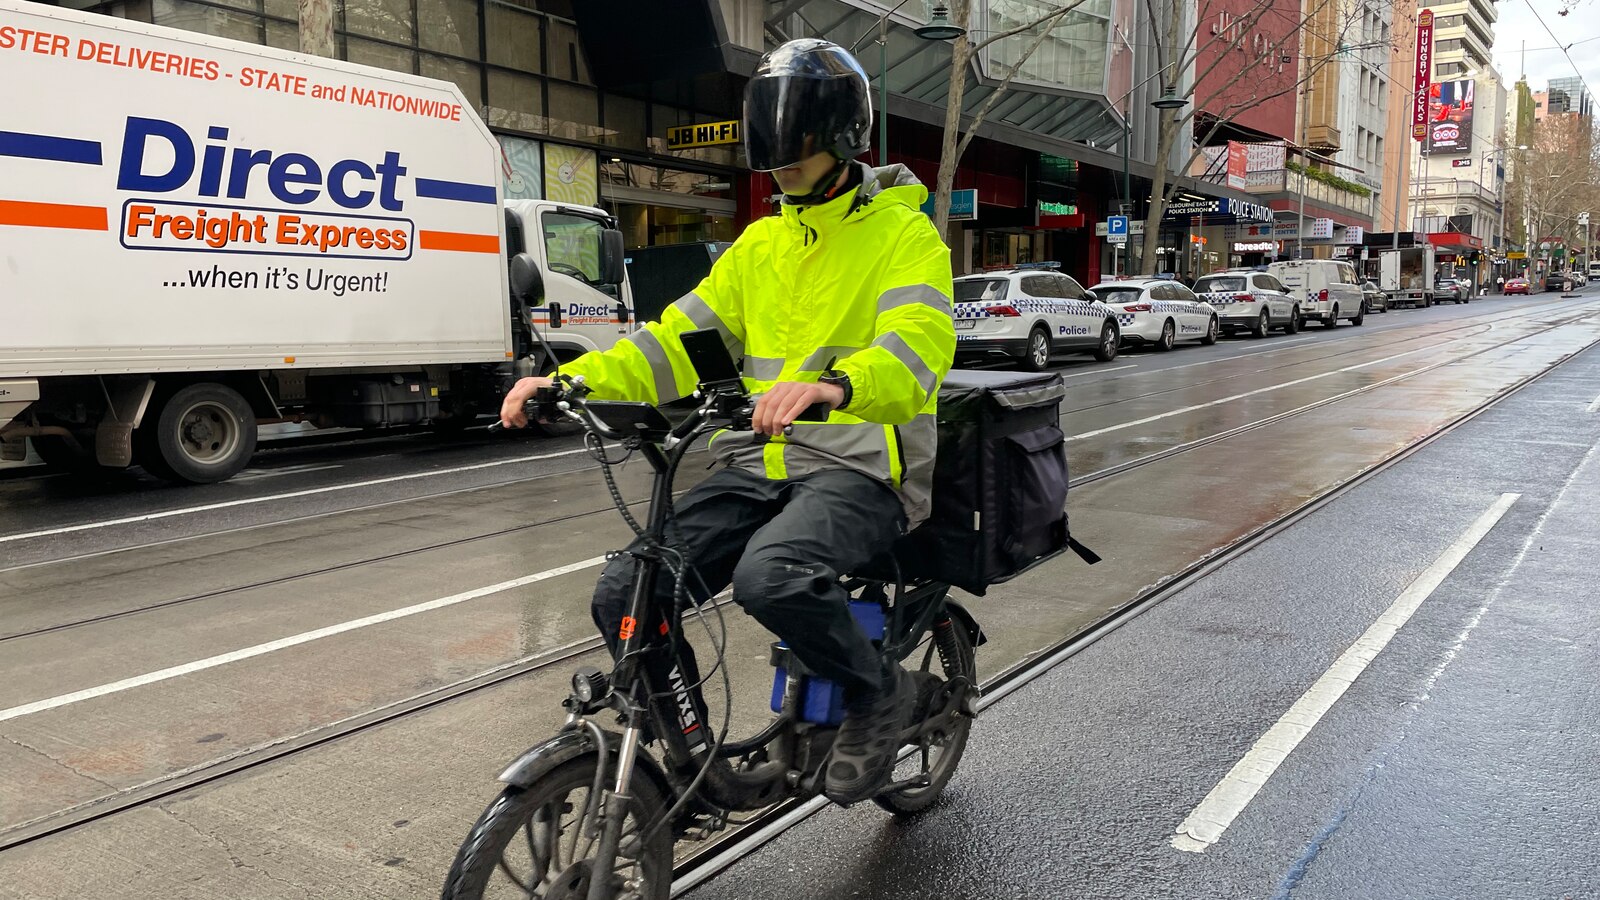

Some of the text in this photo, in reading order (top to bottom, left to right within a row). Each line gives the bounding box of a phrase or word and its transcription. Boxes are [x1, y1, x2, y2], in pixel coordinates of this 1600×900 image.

[1419, 29, 1429, 77] HUNGRY
[0, 26, 70, 57] STER
[77, 39, 219, 80] DELIVERIES
[239, 67, 307, 95] STATE
[311, 84, 346, 102] and
[350, 87, 462, 122] NATIONWIDE
[668, 129, 694, 145] JB
[116, 115, 407, 212] Direct
[1228, 198, 1274, 222] POLICE STATION
[127, 205, 408, 253] Freight Express
[1112, 219, 1122, 231] P
[163, 265, 388, 297] ...when it's Urgent!
[569, 303, 608, 316] Direct
[1059, 325, 1087, 335] Police
